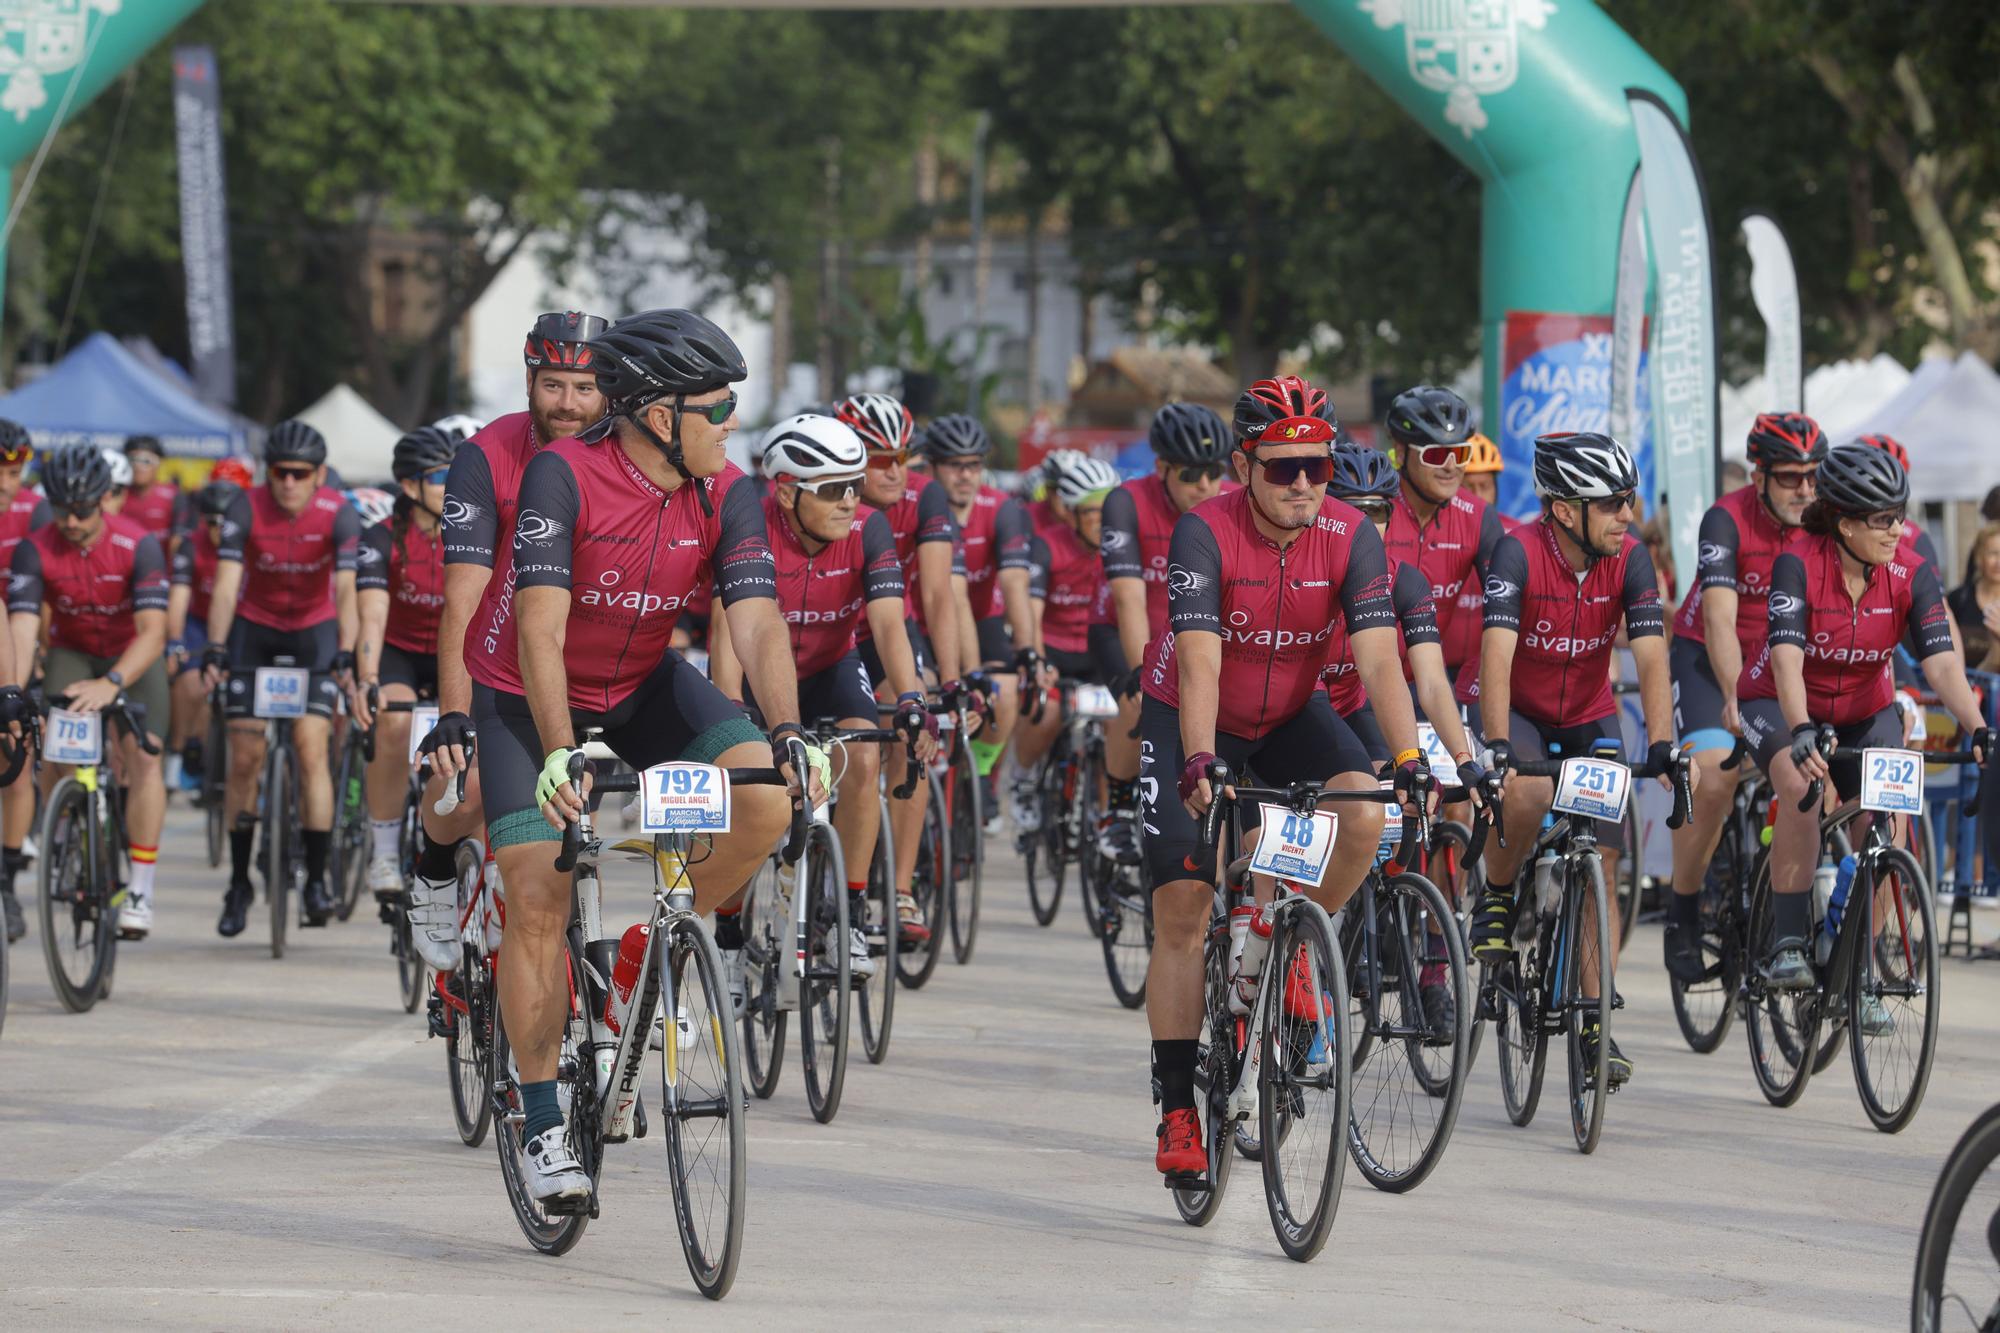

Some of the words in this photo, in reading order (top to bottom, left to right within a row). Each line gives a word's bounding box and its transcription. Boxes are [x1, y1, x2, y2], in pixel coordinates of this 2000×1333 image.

[1804, 642, 1894, 665] avapac
[58, 720, 88, 740] 778
[655, 769, 711, 794] 792
[1572, 764, 1617, 793] 251
[1873, 758, 1914, 784] 252
[660, 796, 686, 805] MIGUEL
[688, 796, 710, 804] ANGEL
[1280, 815, 1314, 847] 48
[1281, 844, 1306, 856] VICENTE
[620, 968, 659, 1093] PINARELLO
